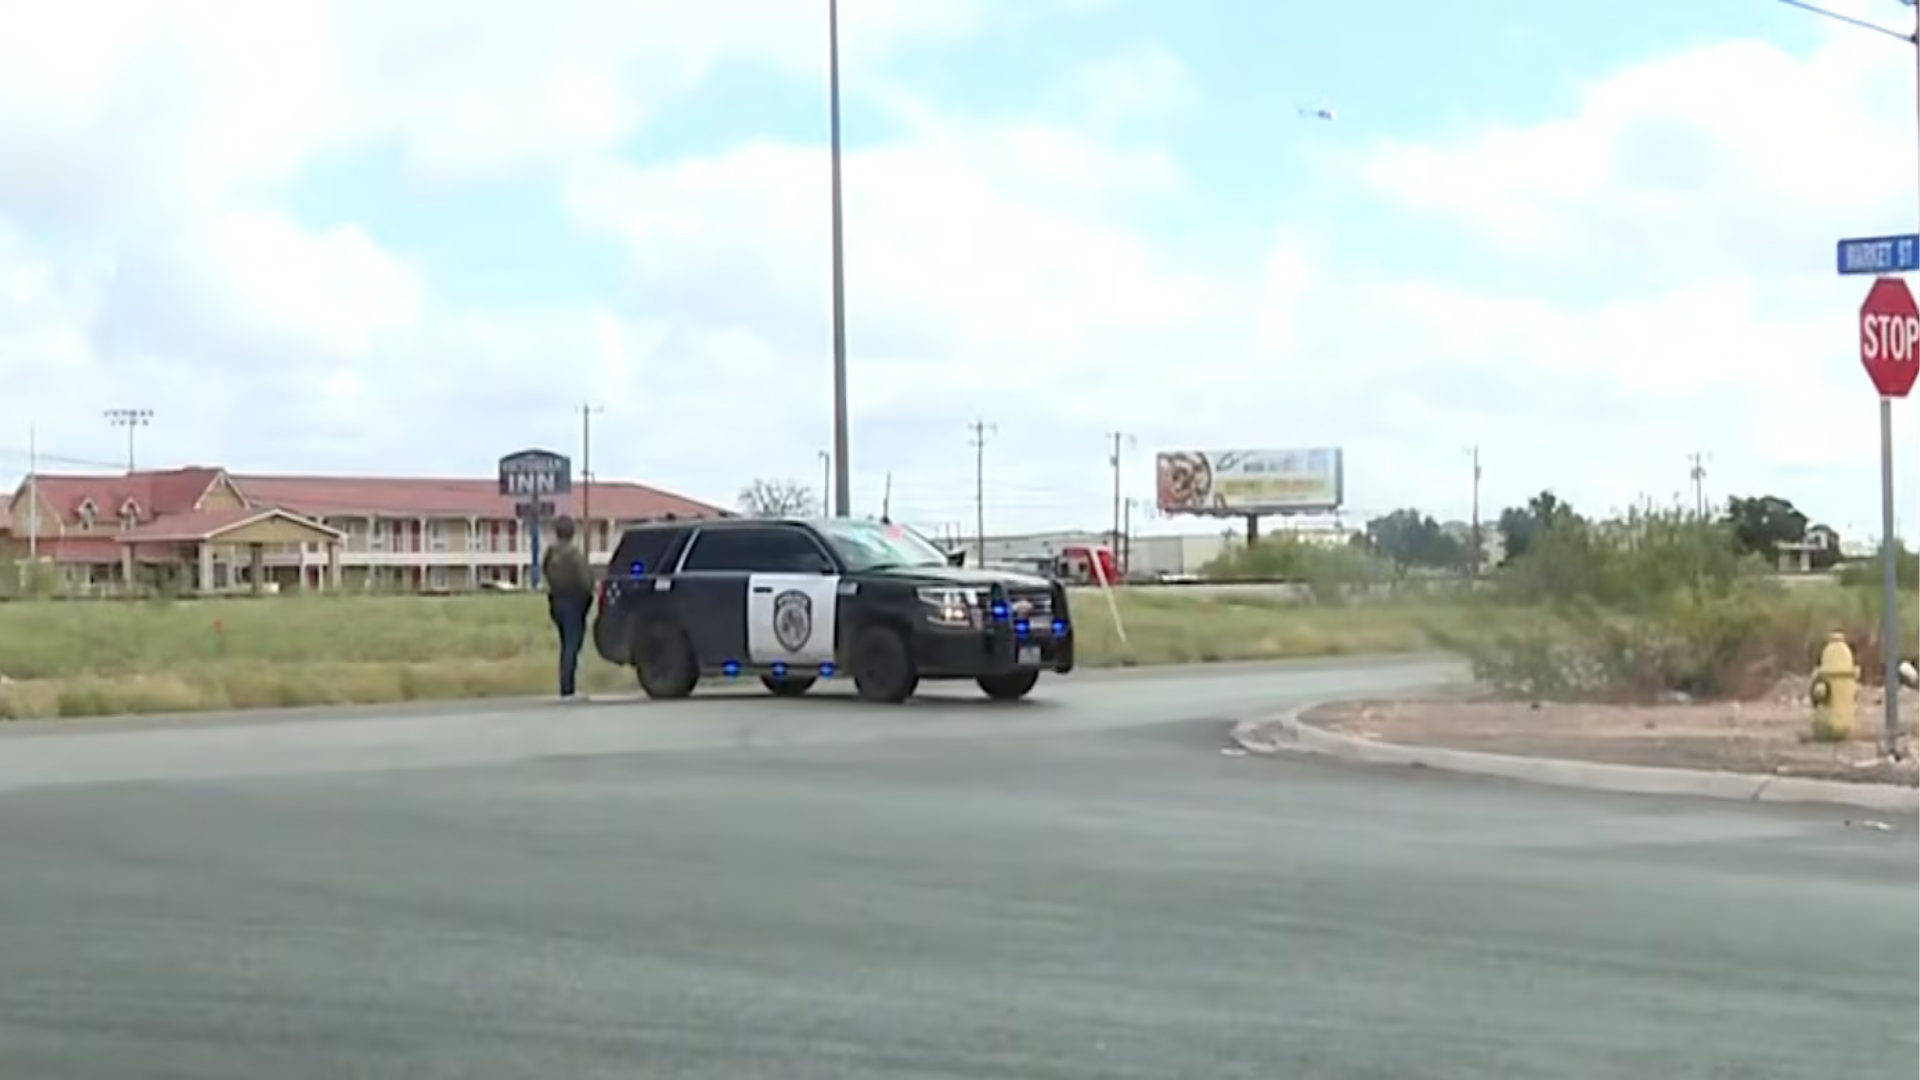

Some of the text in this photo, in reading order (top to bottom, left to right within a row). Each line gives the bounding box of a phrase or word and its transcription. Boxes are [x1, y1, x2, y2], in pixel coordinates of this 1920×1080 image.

[1846, 239, 1914, 269] MARKET ST
[1862, 314, 1919, 360] STOP
[508, 473, 555, 494] INN
